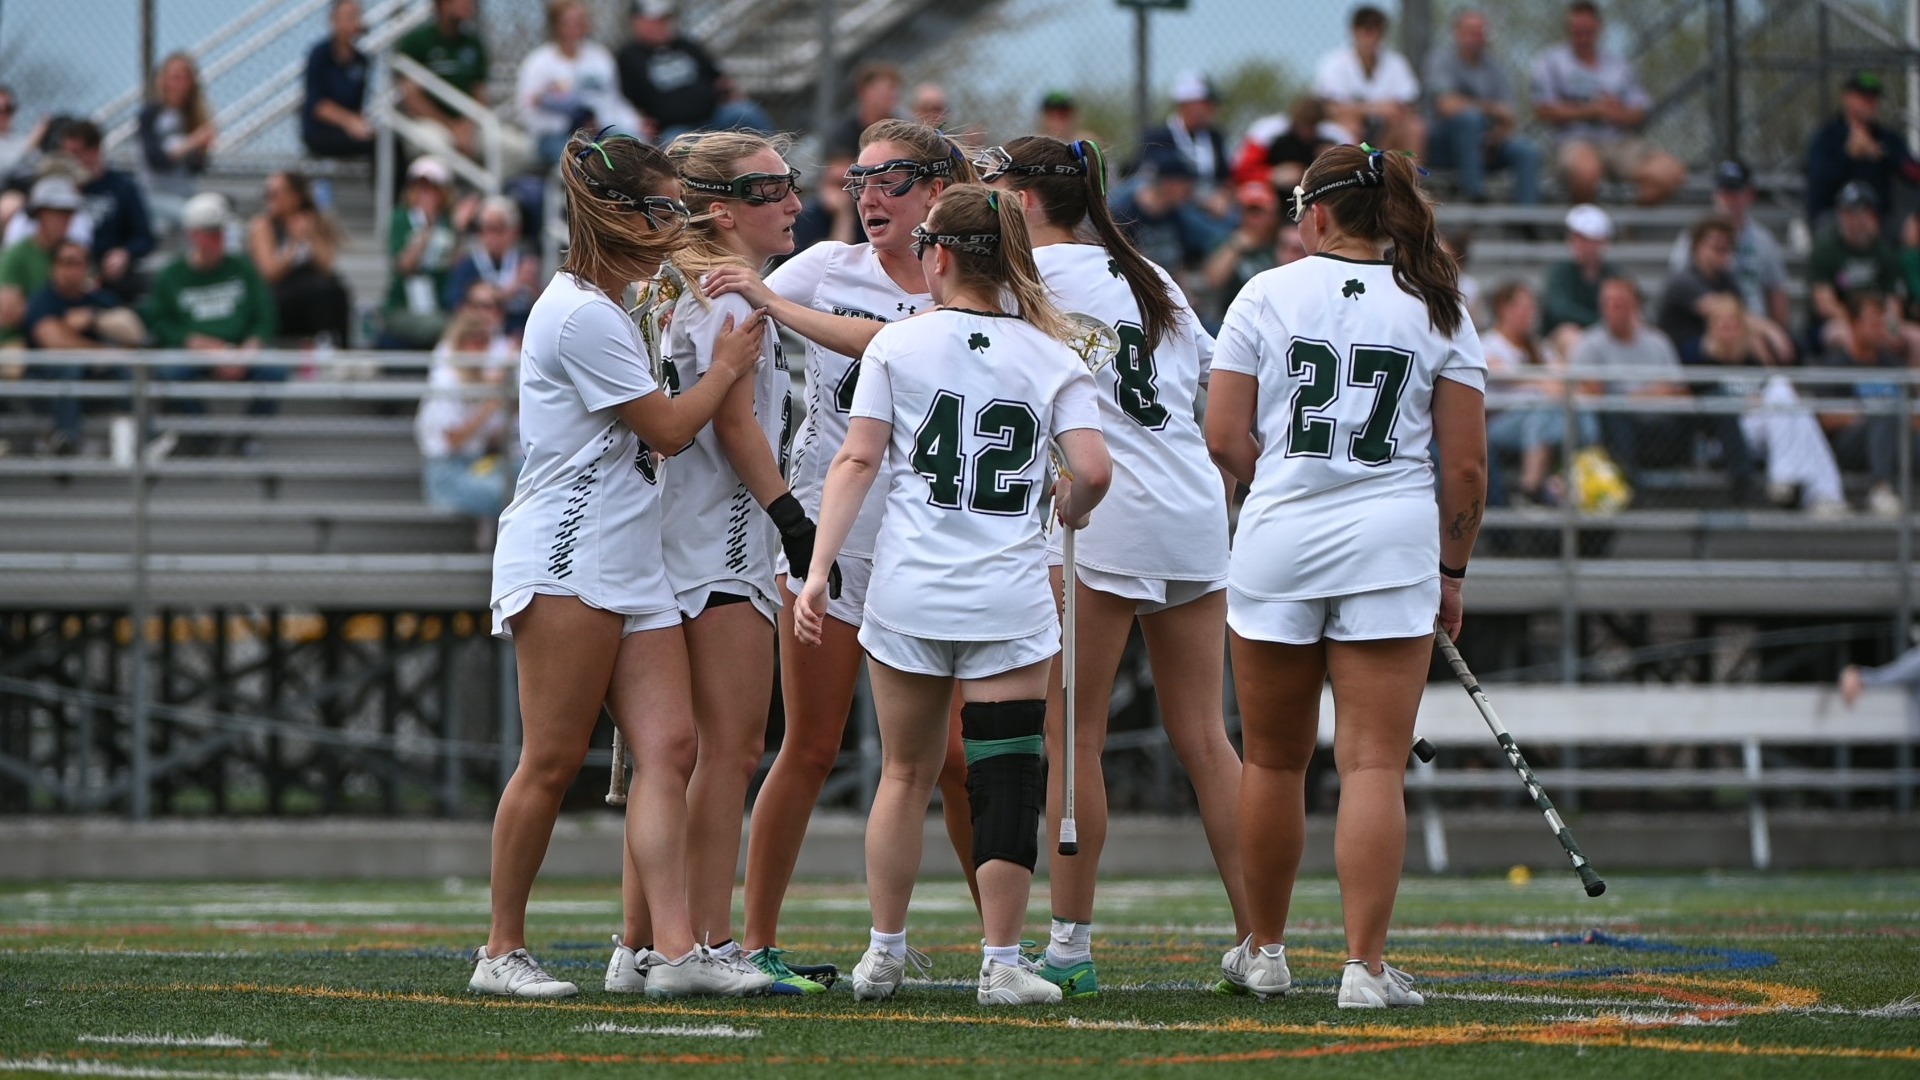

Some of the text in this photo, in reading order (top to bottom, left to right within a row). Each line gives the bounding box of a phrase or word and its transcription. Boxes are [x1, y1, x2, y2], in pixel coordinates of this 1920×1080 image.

[1055, 164, 1080, 175] STX
[1315, 177, 1358, 195] ARMOUR
[937, 235, 961, 245] STX
[970, 233, 999, 244] STX
[962, 245, 992, 255] STX
[1284, 335, 1416, 467] 27
[908, 388, 1041, 518] 42
